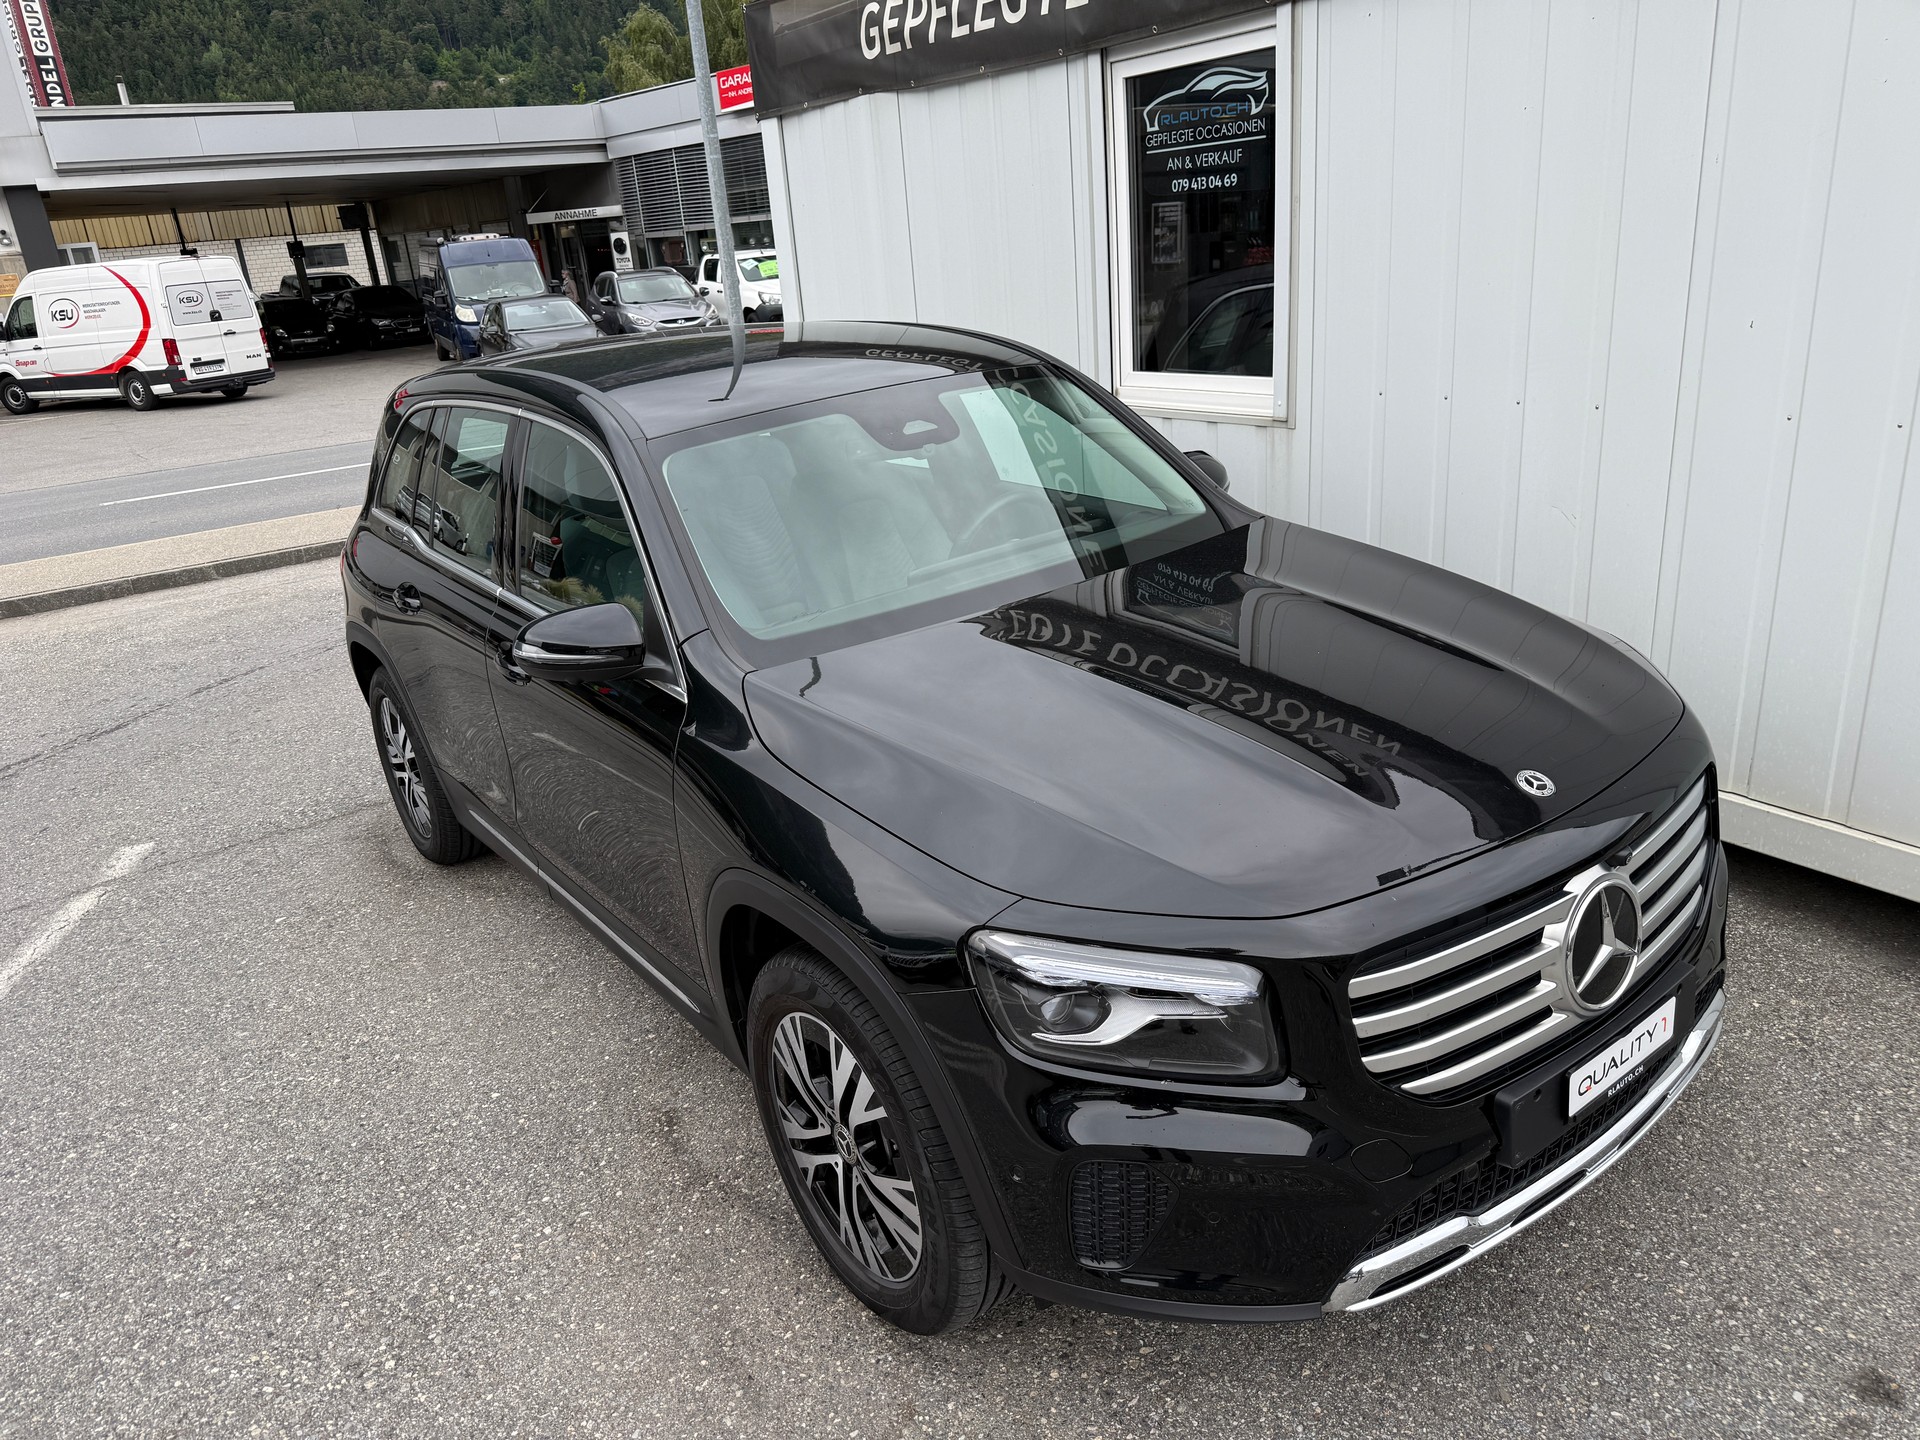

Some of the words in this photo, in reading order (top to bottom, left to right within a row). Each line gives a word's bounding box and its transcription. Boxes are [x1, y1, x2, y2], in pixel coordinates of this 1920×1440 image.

[720, 71, 752, 89] GARA
[1160, 101, 1249, 126] RLAUTO.CH
[1145, 128, 1194, 147] GEPFLEGTE
[1195, 117, 1266, 140] OCCASIONEN
[1166, 156, 1182, 171] AN
[1184, 155, 1193, 169] &
[1194, 148, 1243, 168] VERKAUF
[1171, 178, 1190, 192] 079
[1190, 177, 1207, 190] 413
[1208, 175, 1222, 189] 04
[1223, 173, 1238, 187] 69
[554, 208, 598, 220] ANNAHME
[179, 295, 199, 305] KSU
[50, 308, 74, 322] KSU
[1577, 1022, 1658, 1097] QUALITY
[1661, 1016, 1667, 1032] 1
[1607, 1065, 1644, 1097] RLAUTO.CH
